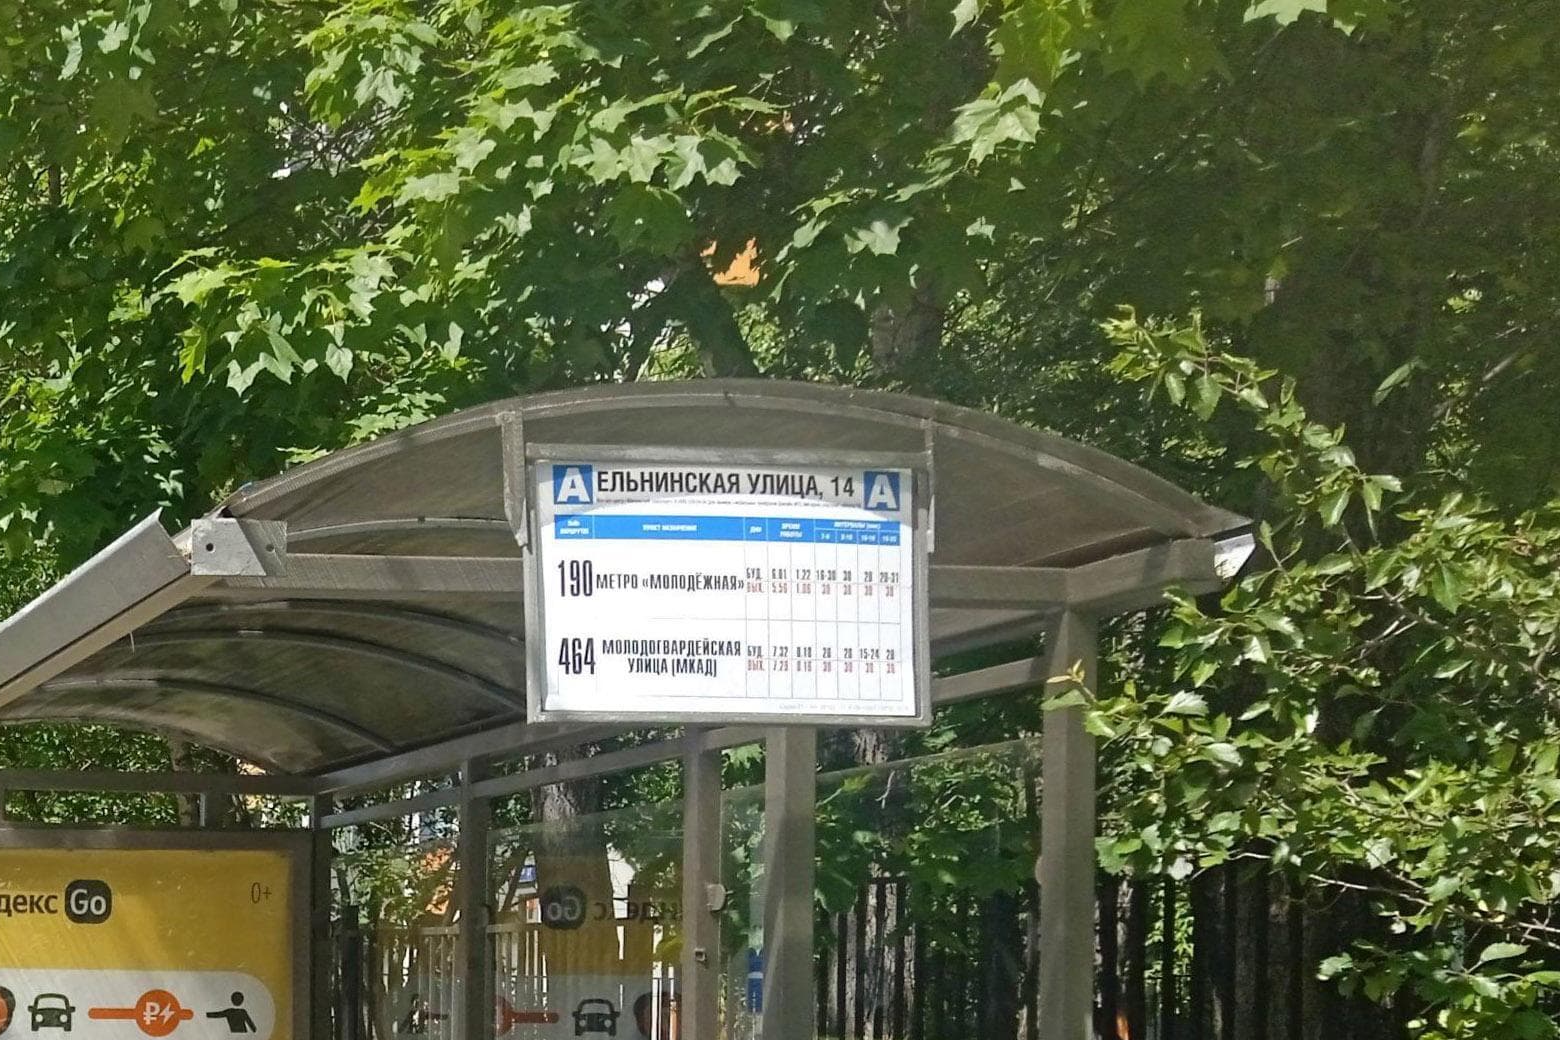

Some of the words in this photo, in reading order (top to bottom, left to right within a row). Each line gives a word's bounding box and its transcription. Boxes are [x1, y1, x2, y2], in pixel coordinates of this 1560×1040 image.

[557, 467, 591, 502] А
[597, 470, 740, 495] ЕЛЬНИНСКАЯ
[747, 473, 824, 499] УЛИЦА,
[831, 476, 855, 497] 14
[866, 474, 898, 509] А
[558, 560, 593, 597] 190
[596, 573, 638, 589] МЕТРО
[642, 572, 744, 592] «МОЛОДЁЖНАЯ»
[559, 637, 596, 675] 464
[602, 638, 741, 657] МОЛОДОГВАРДЕЙСКАЯ
[628, 658, 668, 676] УЛИЦА
[672, 659, 717, 677] (МКАД)
[69, 889, 107, 916] Go
[251, 882, 273, 904] 0+
